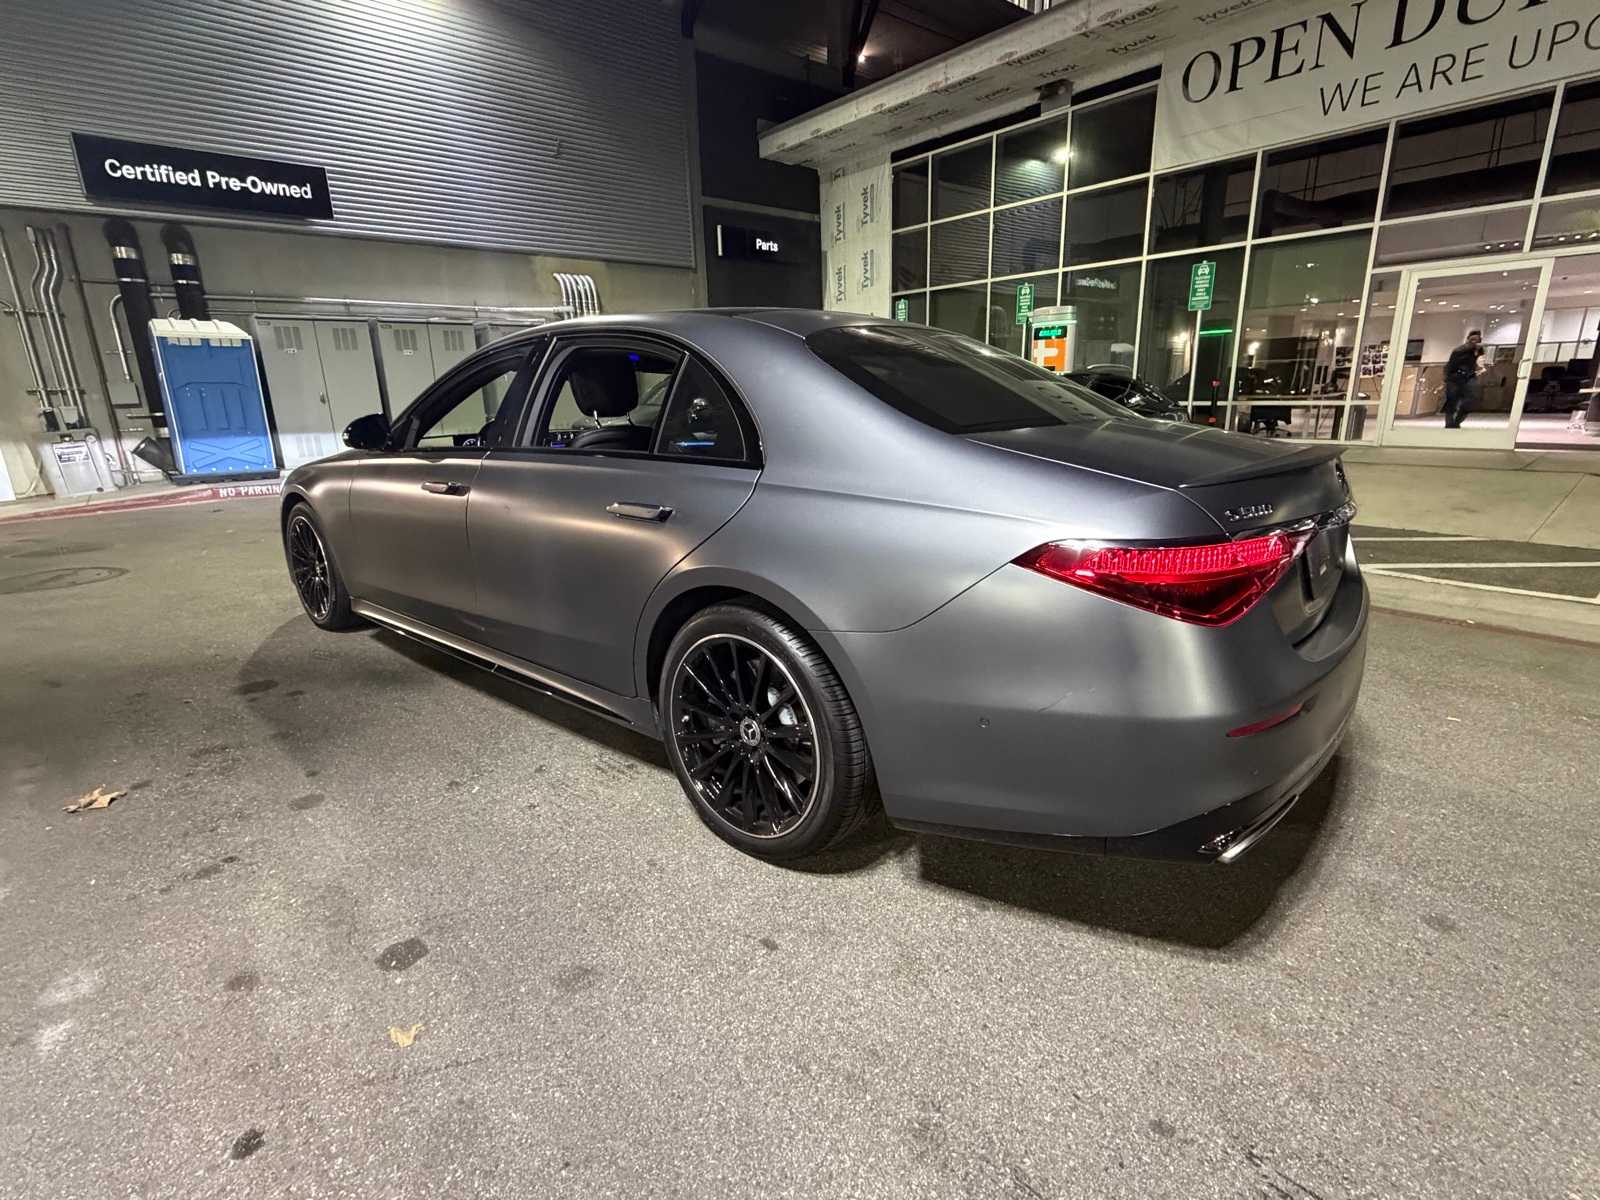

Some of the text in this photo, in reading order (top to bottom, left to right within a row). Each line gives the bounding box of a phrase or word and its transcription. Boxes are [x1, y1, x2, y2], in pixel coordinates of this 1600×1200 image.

[1182, 0, 1369, 103] OPEN
[1319, 71, 1384, 116] WE
[1396, 43, 1489, 99] ARE
[104, 158, 313, 199] Certified Pre-Owned
[834, 205, 843, 243] Tyvek
[861, 185, 870, 227] Tyvek
[755, 238, 779, 252] Parts
[835, 266, 844, 303] Tyvek
[861, 250, 870, 289] Tyvek
[219, 485, 280, 498] NO PARKIN
